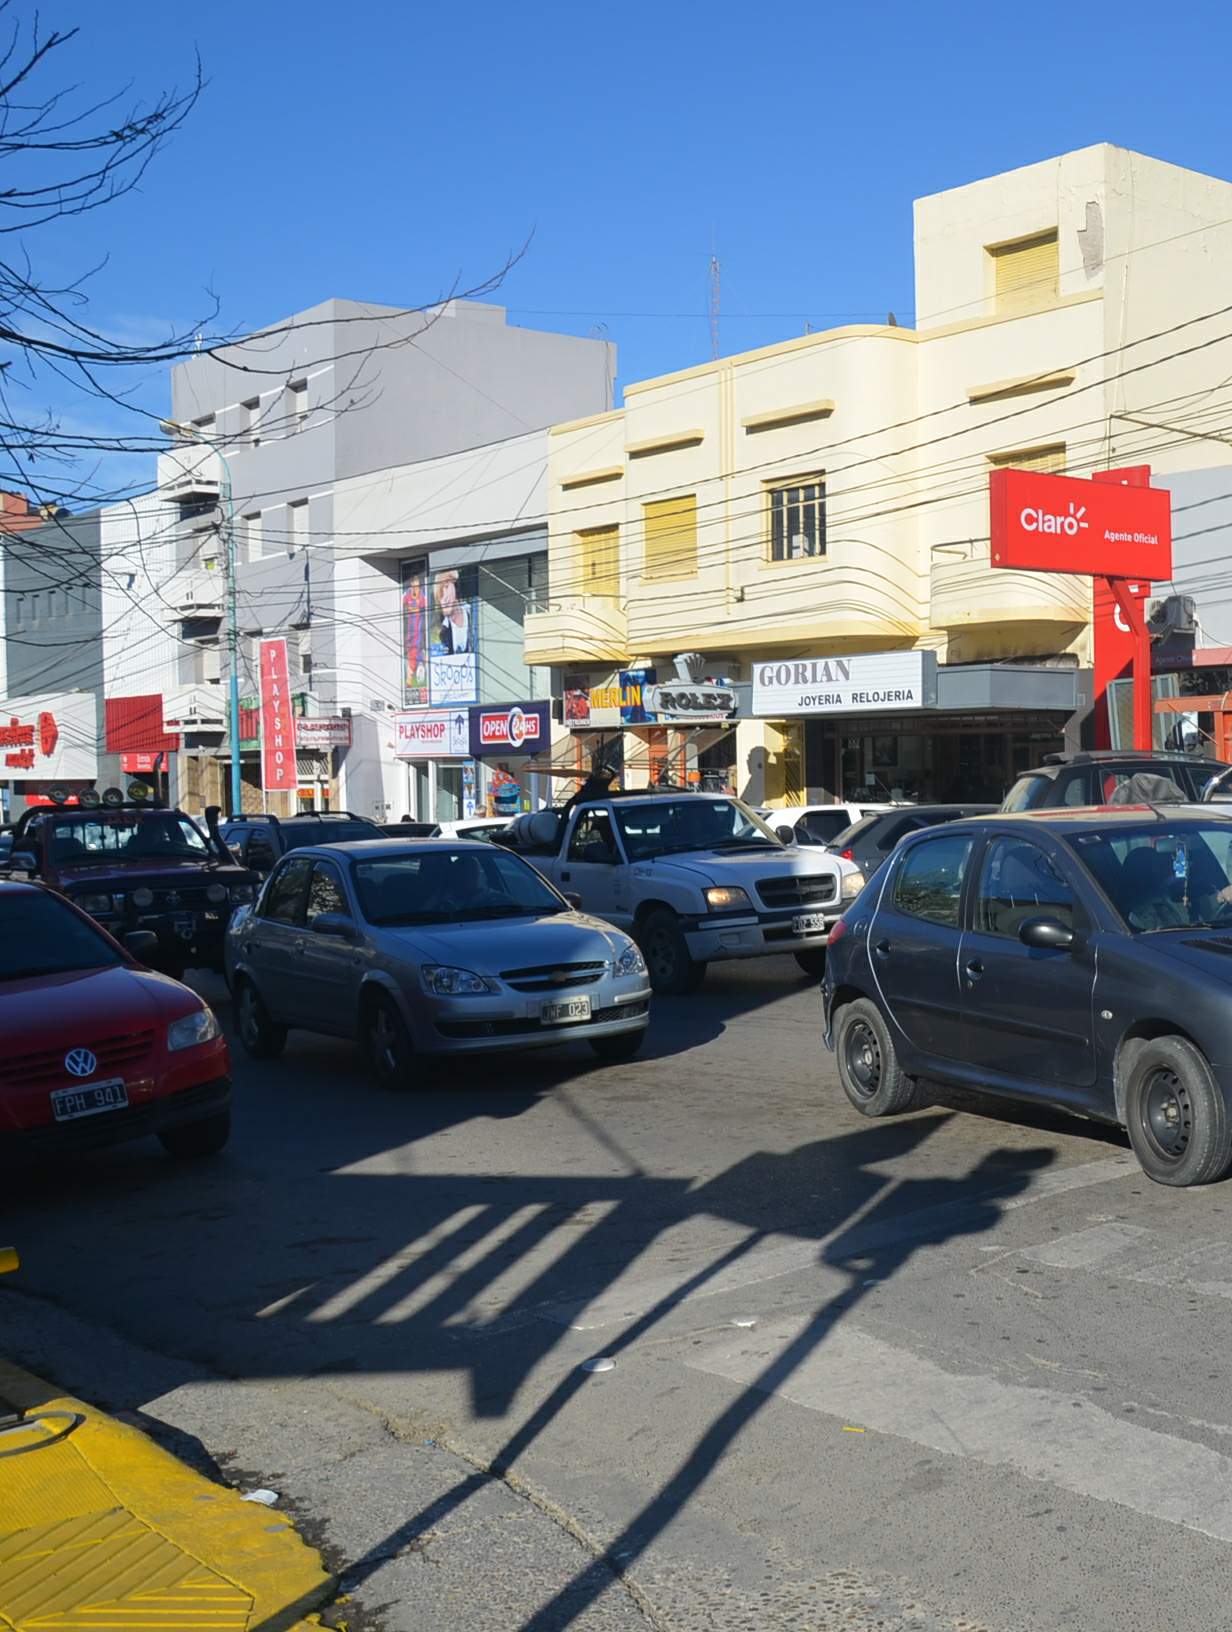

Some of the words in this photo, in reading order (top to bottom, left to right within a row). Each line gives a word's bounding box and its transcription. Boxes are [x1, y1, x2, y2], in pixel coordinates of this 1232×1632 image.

[1020, 507, 1078, 535] Claro
[1104, 530, 1132, 543] Agente
[1134, 533, 1158, 545] Oficial
[759, 659, 852, 687] GORIAN
[590, 685, 641, 709] MERLIN
[658, 691, 734, 712] ROLEX
[798, 694, 842, 707] JOYERIA
[852, 689, 913, 704] RELOJERIA
[269, 650, 284, 782] PLAYSHOP
[399, 723, 446, 740] PLAYSHOP
[483, 720, 507, 737] OPEN
[568, 1001, 589, 1016] 023
[94, 1086, 124, 1107] 941
